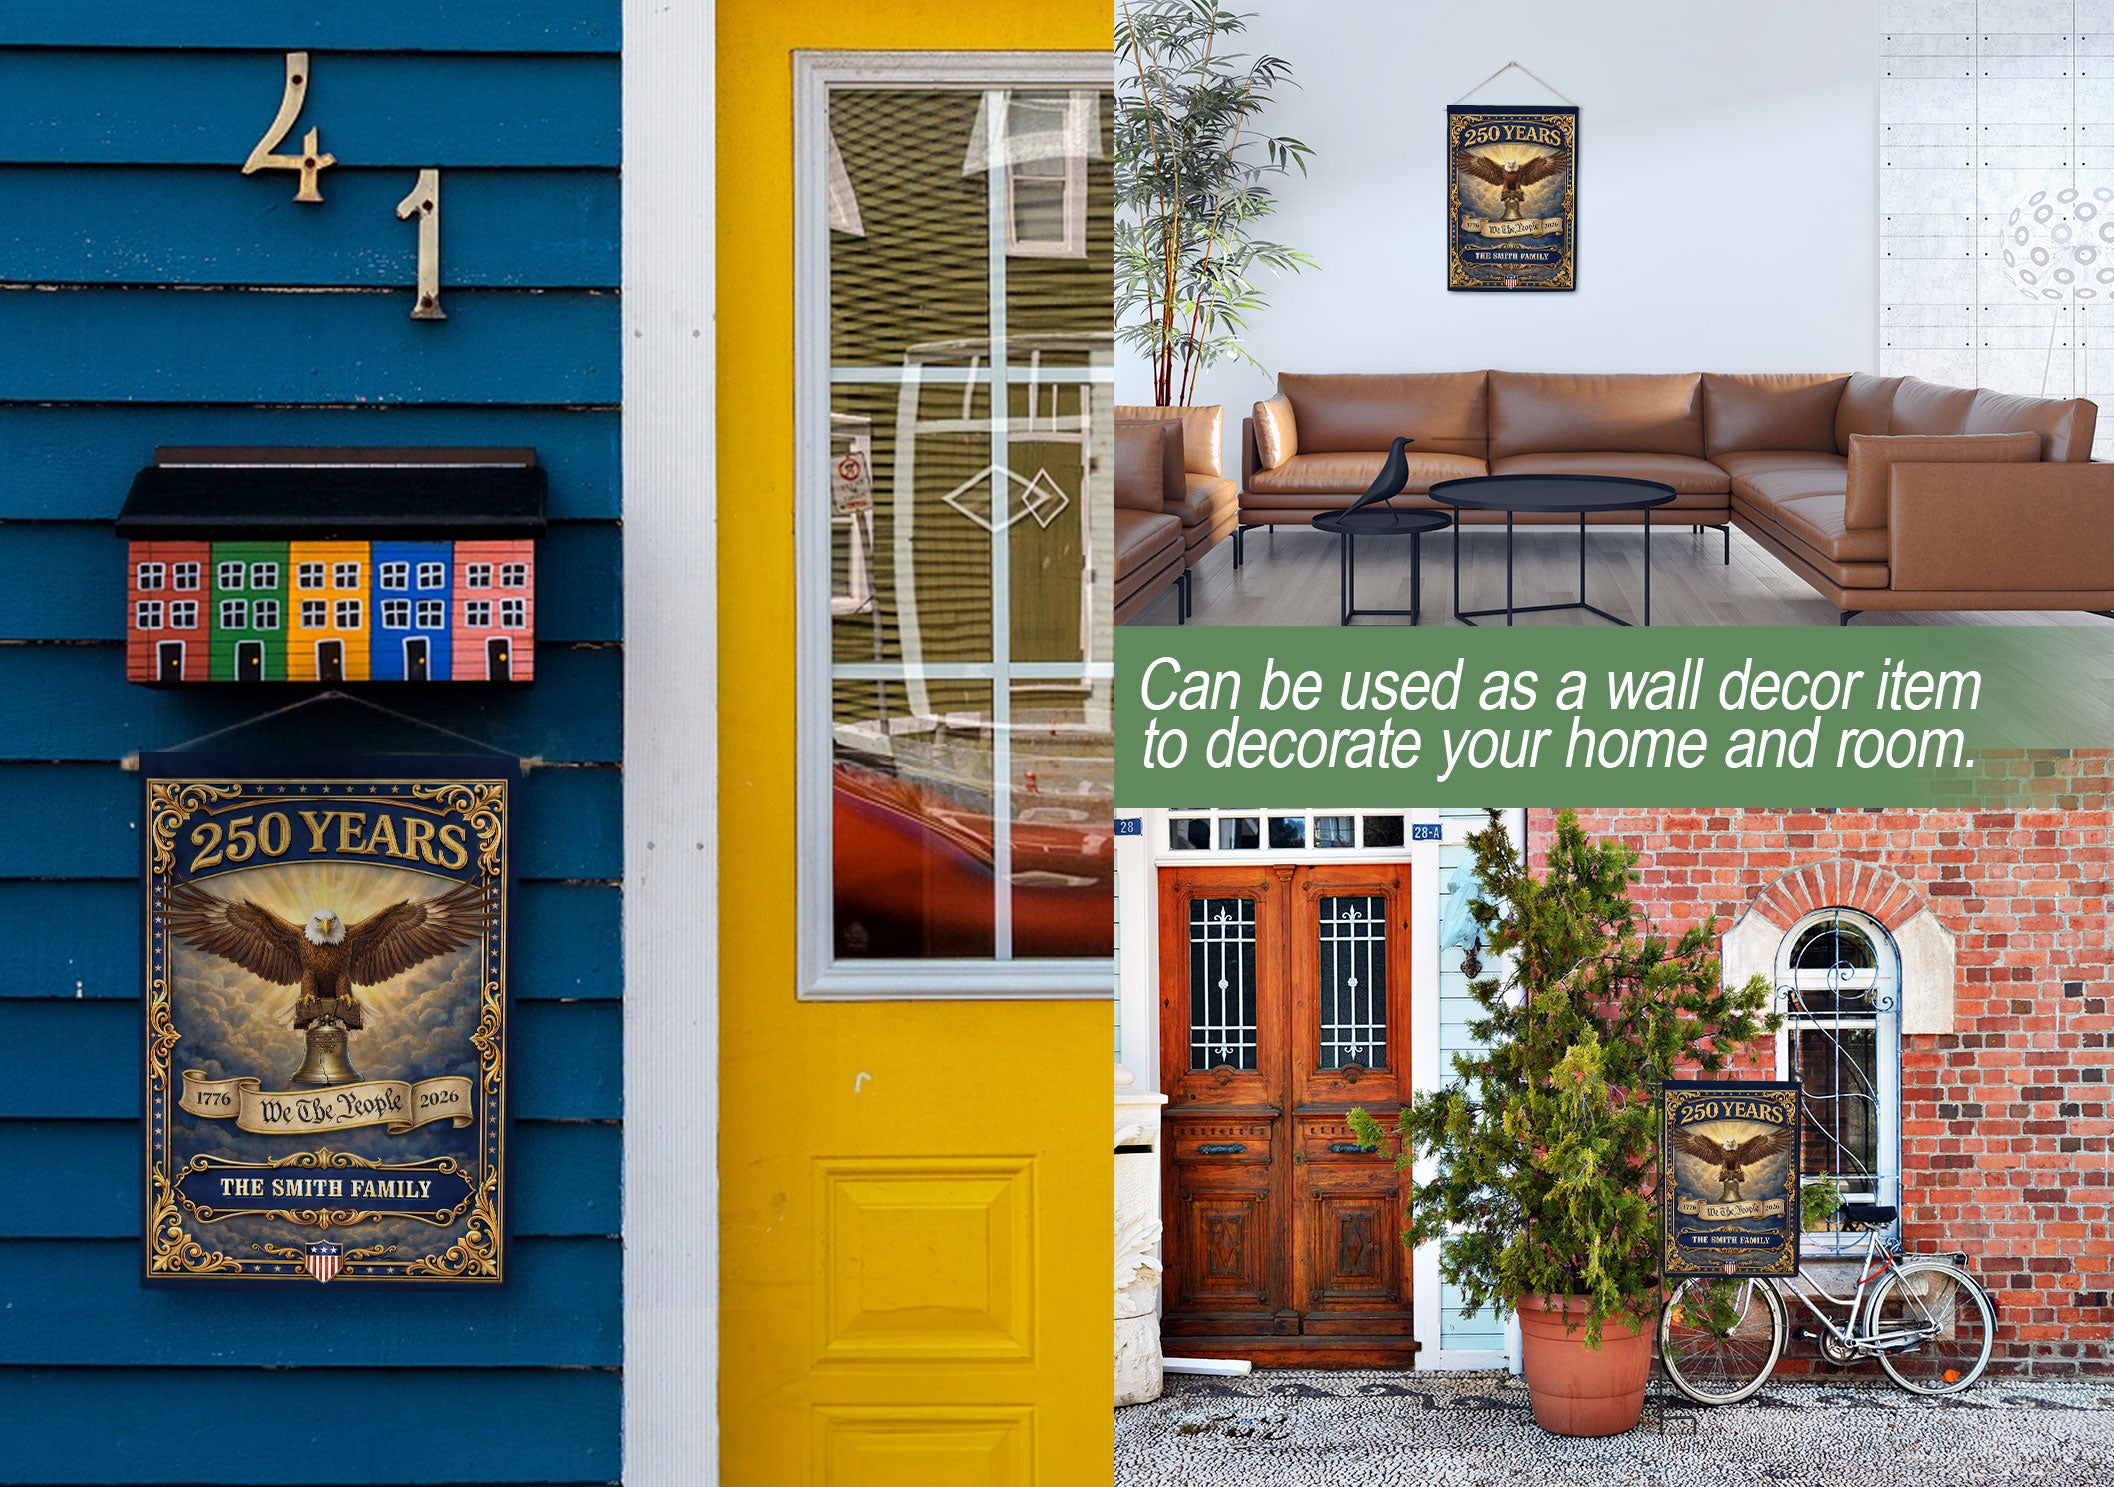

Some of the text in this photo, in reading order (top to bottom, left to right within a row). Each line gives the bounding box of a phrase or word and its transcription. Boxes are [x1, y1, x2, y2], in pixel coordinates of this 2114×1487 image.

[1464, 124, 1563, 148] 250 YEARS
[1489, 225, 1500, 234] We
[1501, 224, 1516, 235] The
[1475, 252, 1549, 261] THE SMITH FAMILY
[1120, 821, 1134, 833] 28
[1414, 826, 1440, 839] 28-A
[189, 810, 470, 875] 250 YEARS
[196, 1091, 232, 1106] 1776
[260, 1087, 405, 1125] We The People
[420, 1089, 460, 1109] 2026
[1680, 1101, 1784, 1125] 250 YEARS
[220, 1178, 432, 1200] THE SMITH FAMILY
[1707, 1208, 1719, 1217] We
[1719, 1207, 1734, 1217] The
[1692, 1236, 1770, 1245] THE SMITH FAMILY
